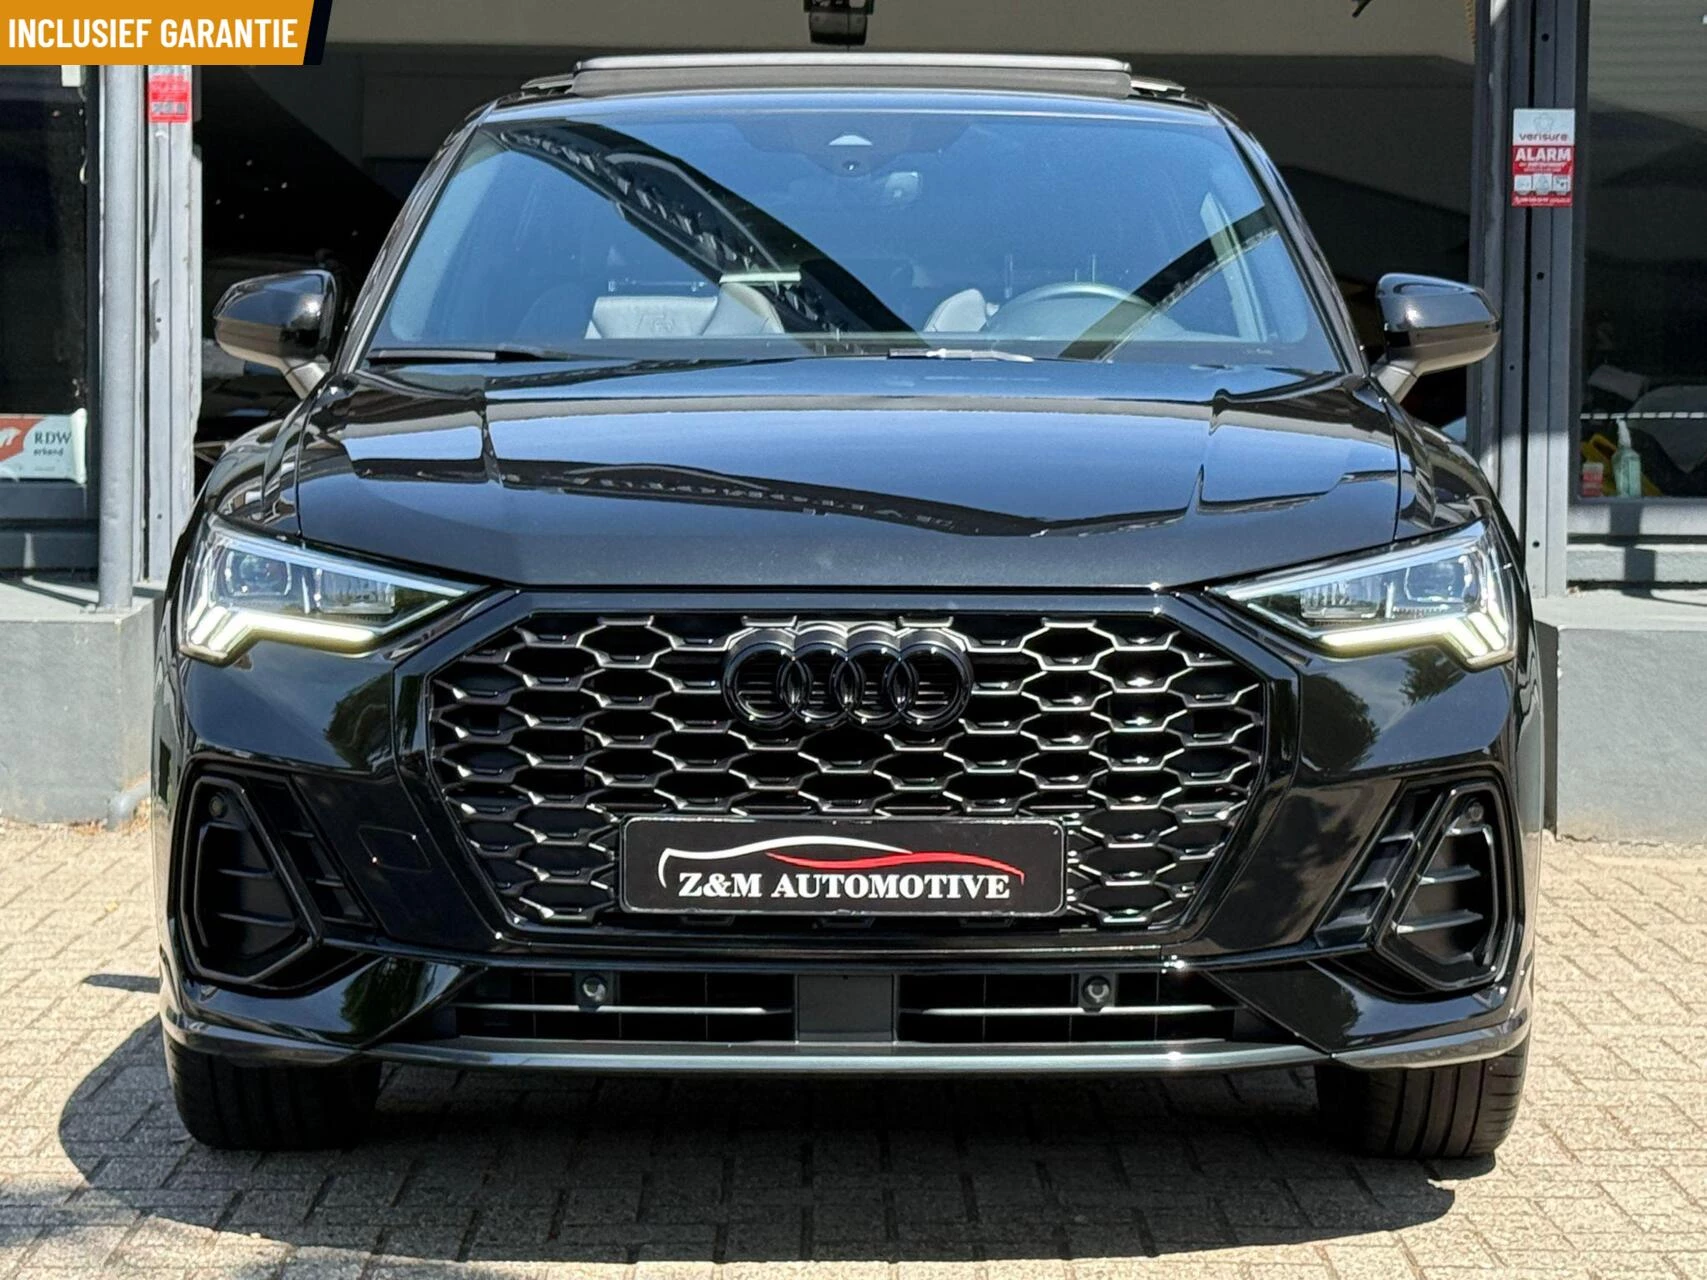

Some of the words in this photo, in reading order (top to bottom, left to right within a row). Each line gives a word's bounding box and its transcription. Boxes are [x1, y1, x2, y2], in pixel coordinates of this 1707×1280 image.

[1519, 133, 1568, 142] verisure
[1514, 147, 1571, 162] ALARM
[34, 431, 72, 444] RDW
[678, 872, 762, 899] Z&M
[770, 872, 1011, 900] AUTOMOTIVE
